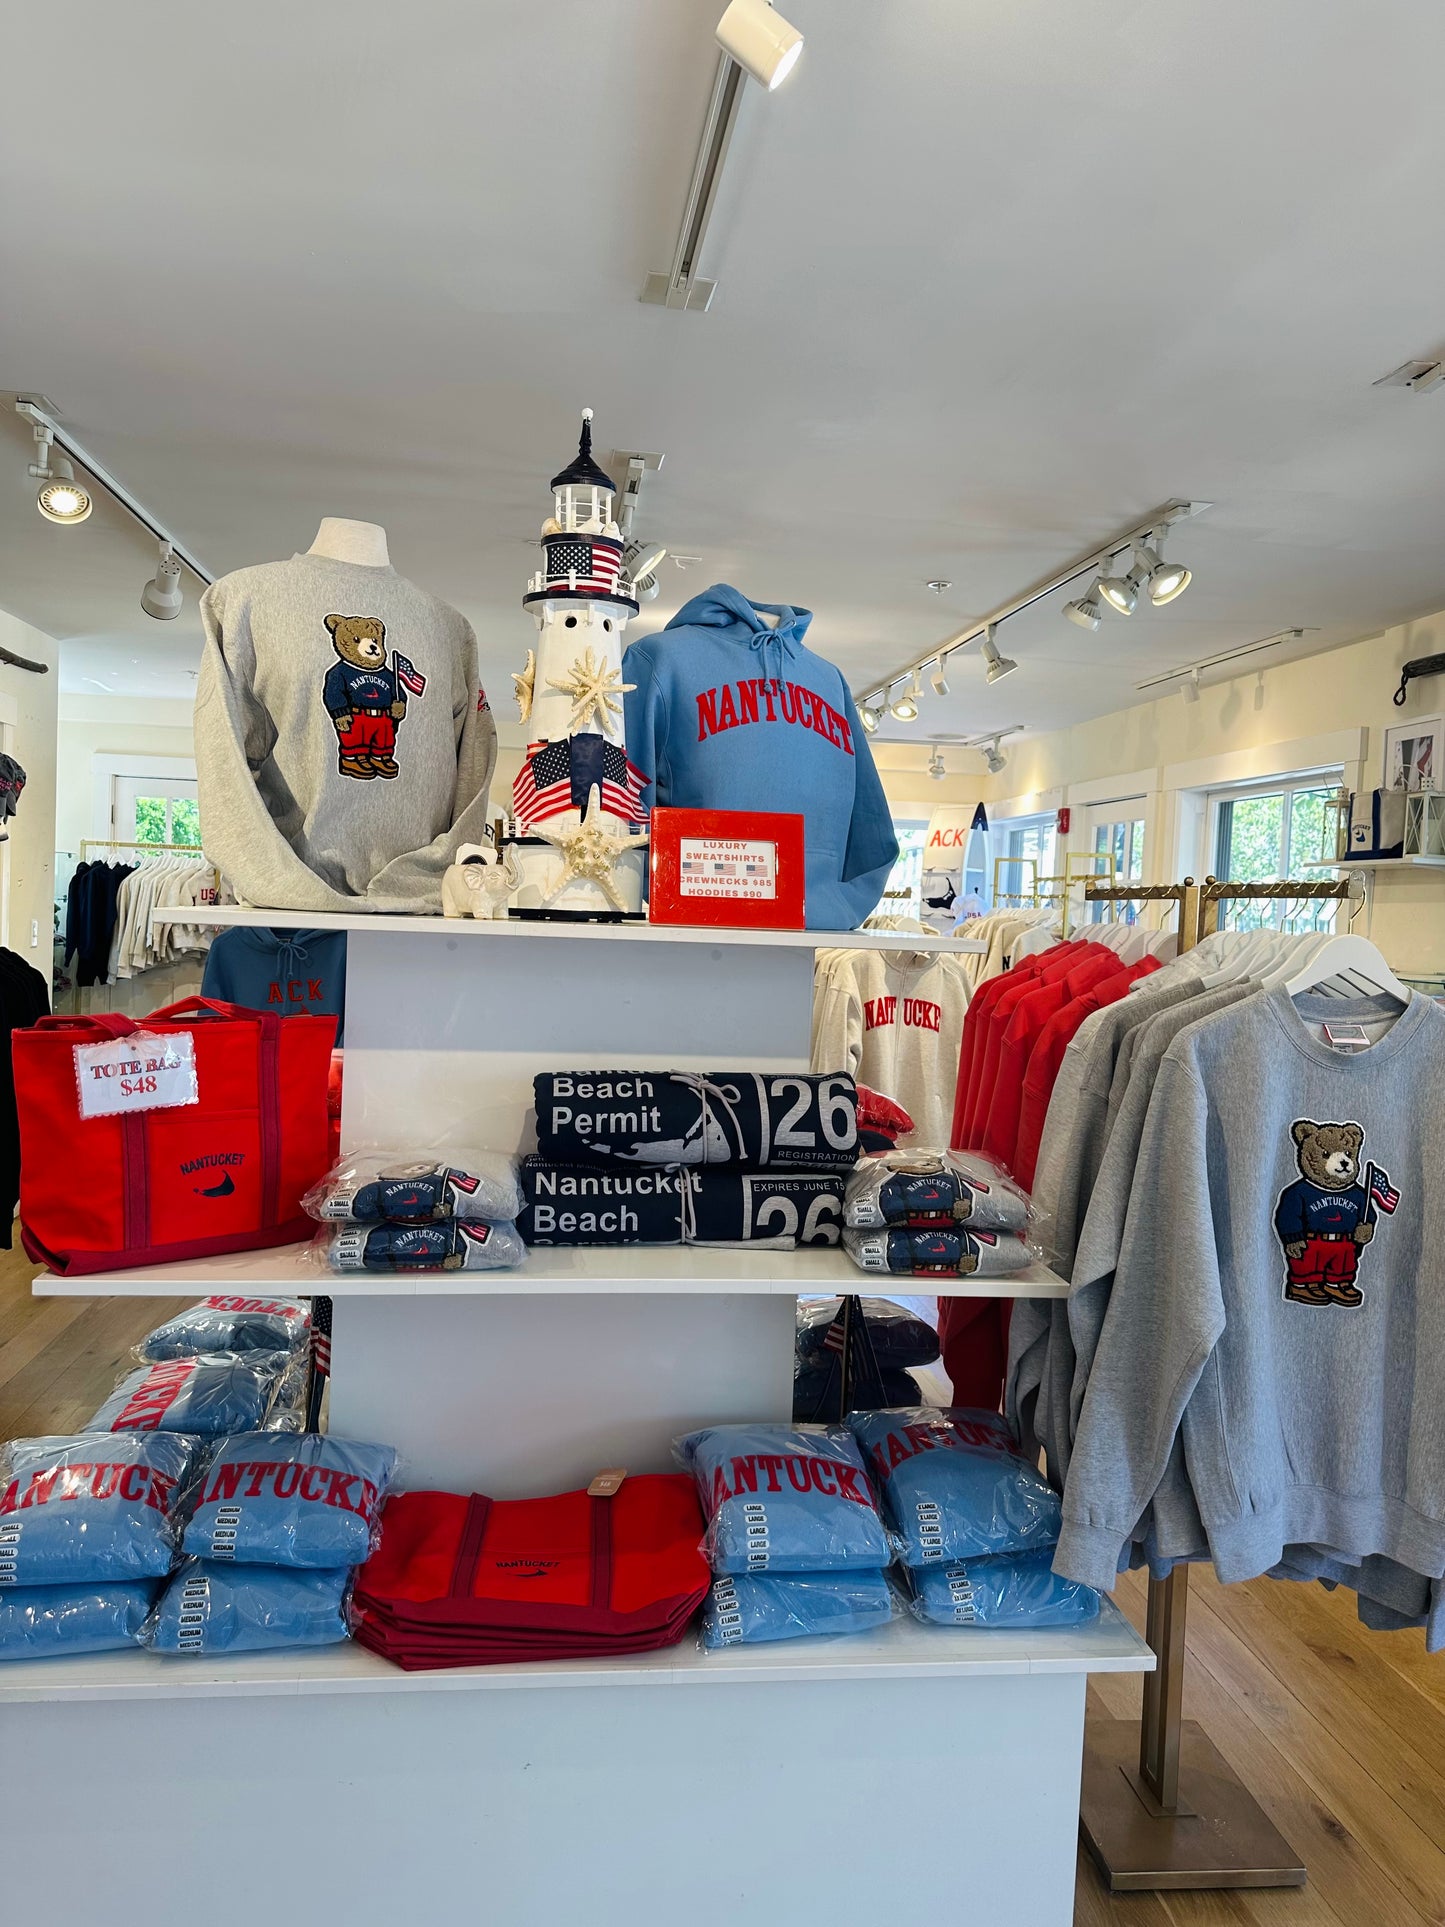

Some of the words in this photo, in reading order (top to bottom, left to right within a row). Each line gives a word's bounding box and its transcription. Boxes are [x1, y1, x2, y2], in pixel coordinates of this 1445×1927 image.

[350, 675, 390, 691] NANTUCKET
[695, 679, 855, 756] NANTUCKET
[703, 841, 748, 850] LUXURY
[929, 828, 965, 847] ACK
[686, 853, 765, 863] SWEATSHIRTS
[680, 876, 748, 886] CREWNECKS
[753, 879, 772, 887] $85
[688, 889, 739, 897] HOODIES
[743, 890, 762, 898] $90
[268, 978, 324, 1003] ACK
[91, 1060, 142, 1080] TOTE
[145, 1055, 182, 1072] BAG
[120, 1075, 157, 1097] $48
[553, 1077, 654, 1098] Beach
[552, 1105, 661, 1135] Permit
[771, 1077, 858, 1150] 26
[180, 1153, 245, 1175] NANTUCKET
[778, 1151, 855, 1163] REGISTRATION
[385, 1182, 434, 1196] NANTUCKET
[535, 1172, 703, 1196] Nantucket
[753, 1183, 800, 1192] EXPIRES
[803, 1182, 831, 1191] JUNE
[906, 1179, 951, 1193] NANTUCKET
[1310, 1197, 1358, 1213] NANTUCKET
[534, 1205, 639, 1233] Beach
[756, 1193, 842, 1245] 26
[395, 1229, 445, 1247] NANTUCKET
[914, 1231, 959, 1245] NANTUCKET
[340, 1251, 357, 1259] SMALL
[181, 1615, 202, 1623] MEDIUM
[180, 1629, 201, 1637] MEDIUM
